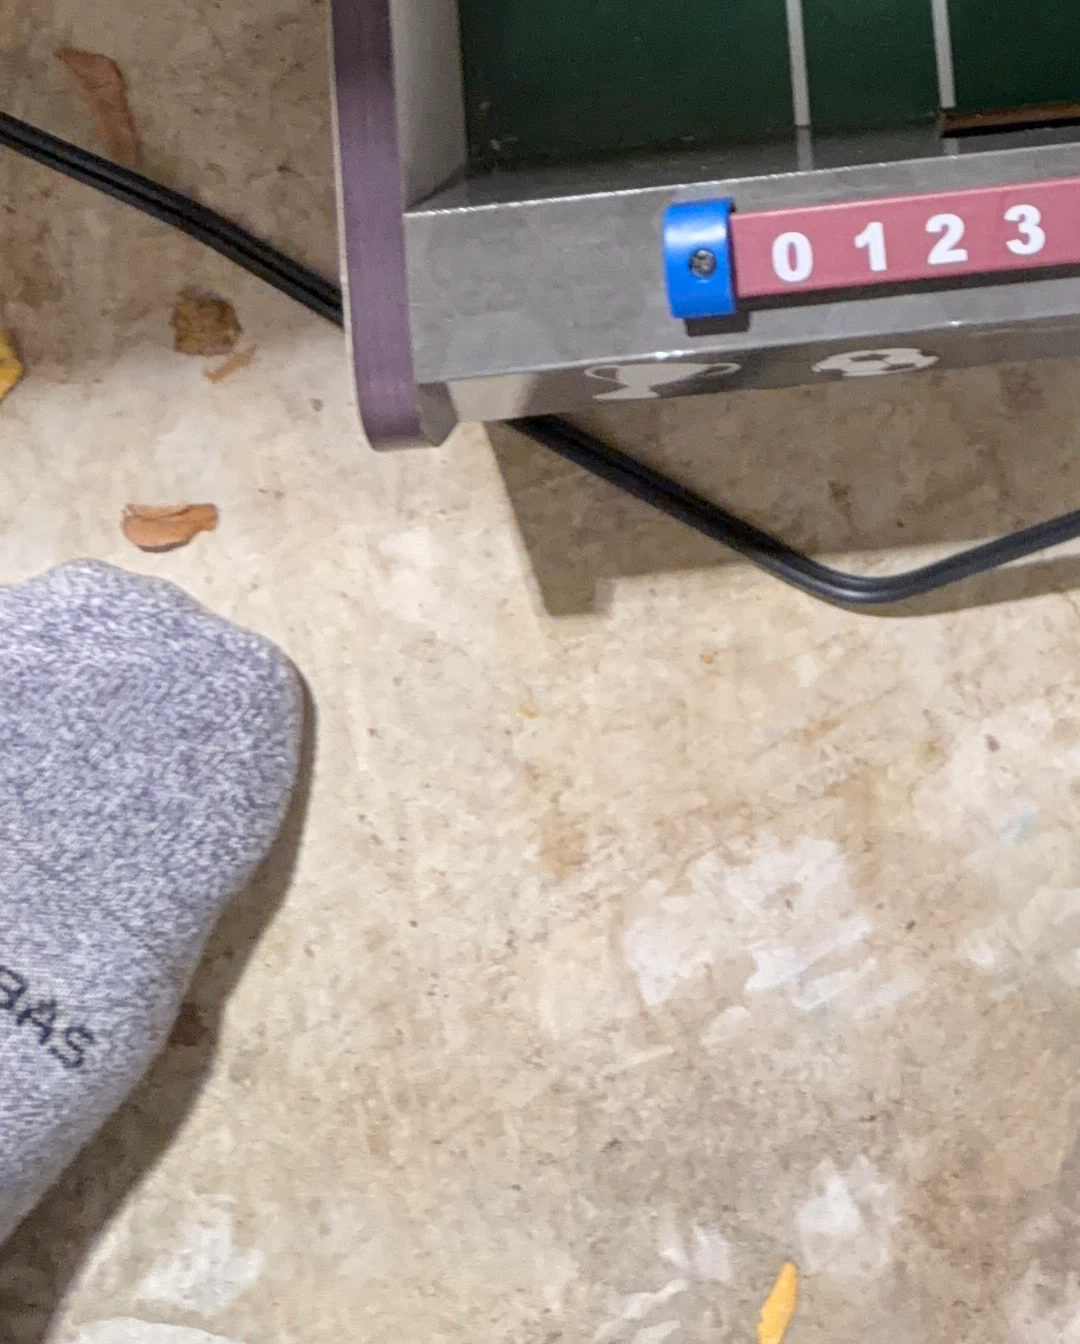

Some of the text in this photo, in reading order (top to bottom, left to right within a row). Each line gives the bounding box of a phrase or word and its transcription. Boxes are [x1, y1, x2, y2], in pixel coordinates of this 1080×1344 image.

[771, 231, 814, 283] 0
[854, 221, 888, 272] 1
[924, 213, 969, 266] 2
[1003, 203, 1046, 256] 3
